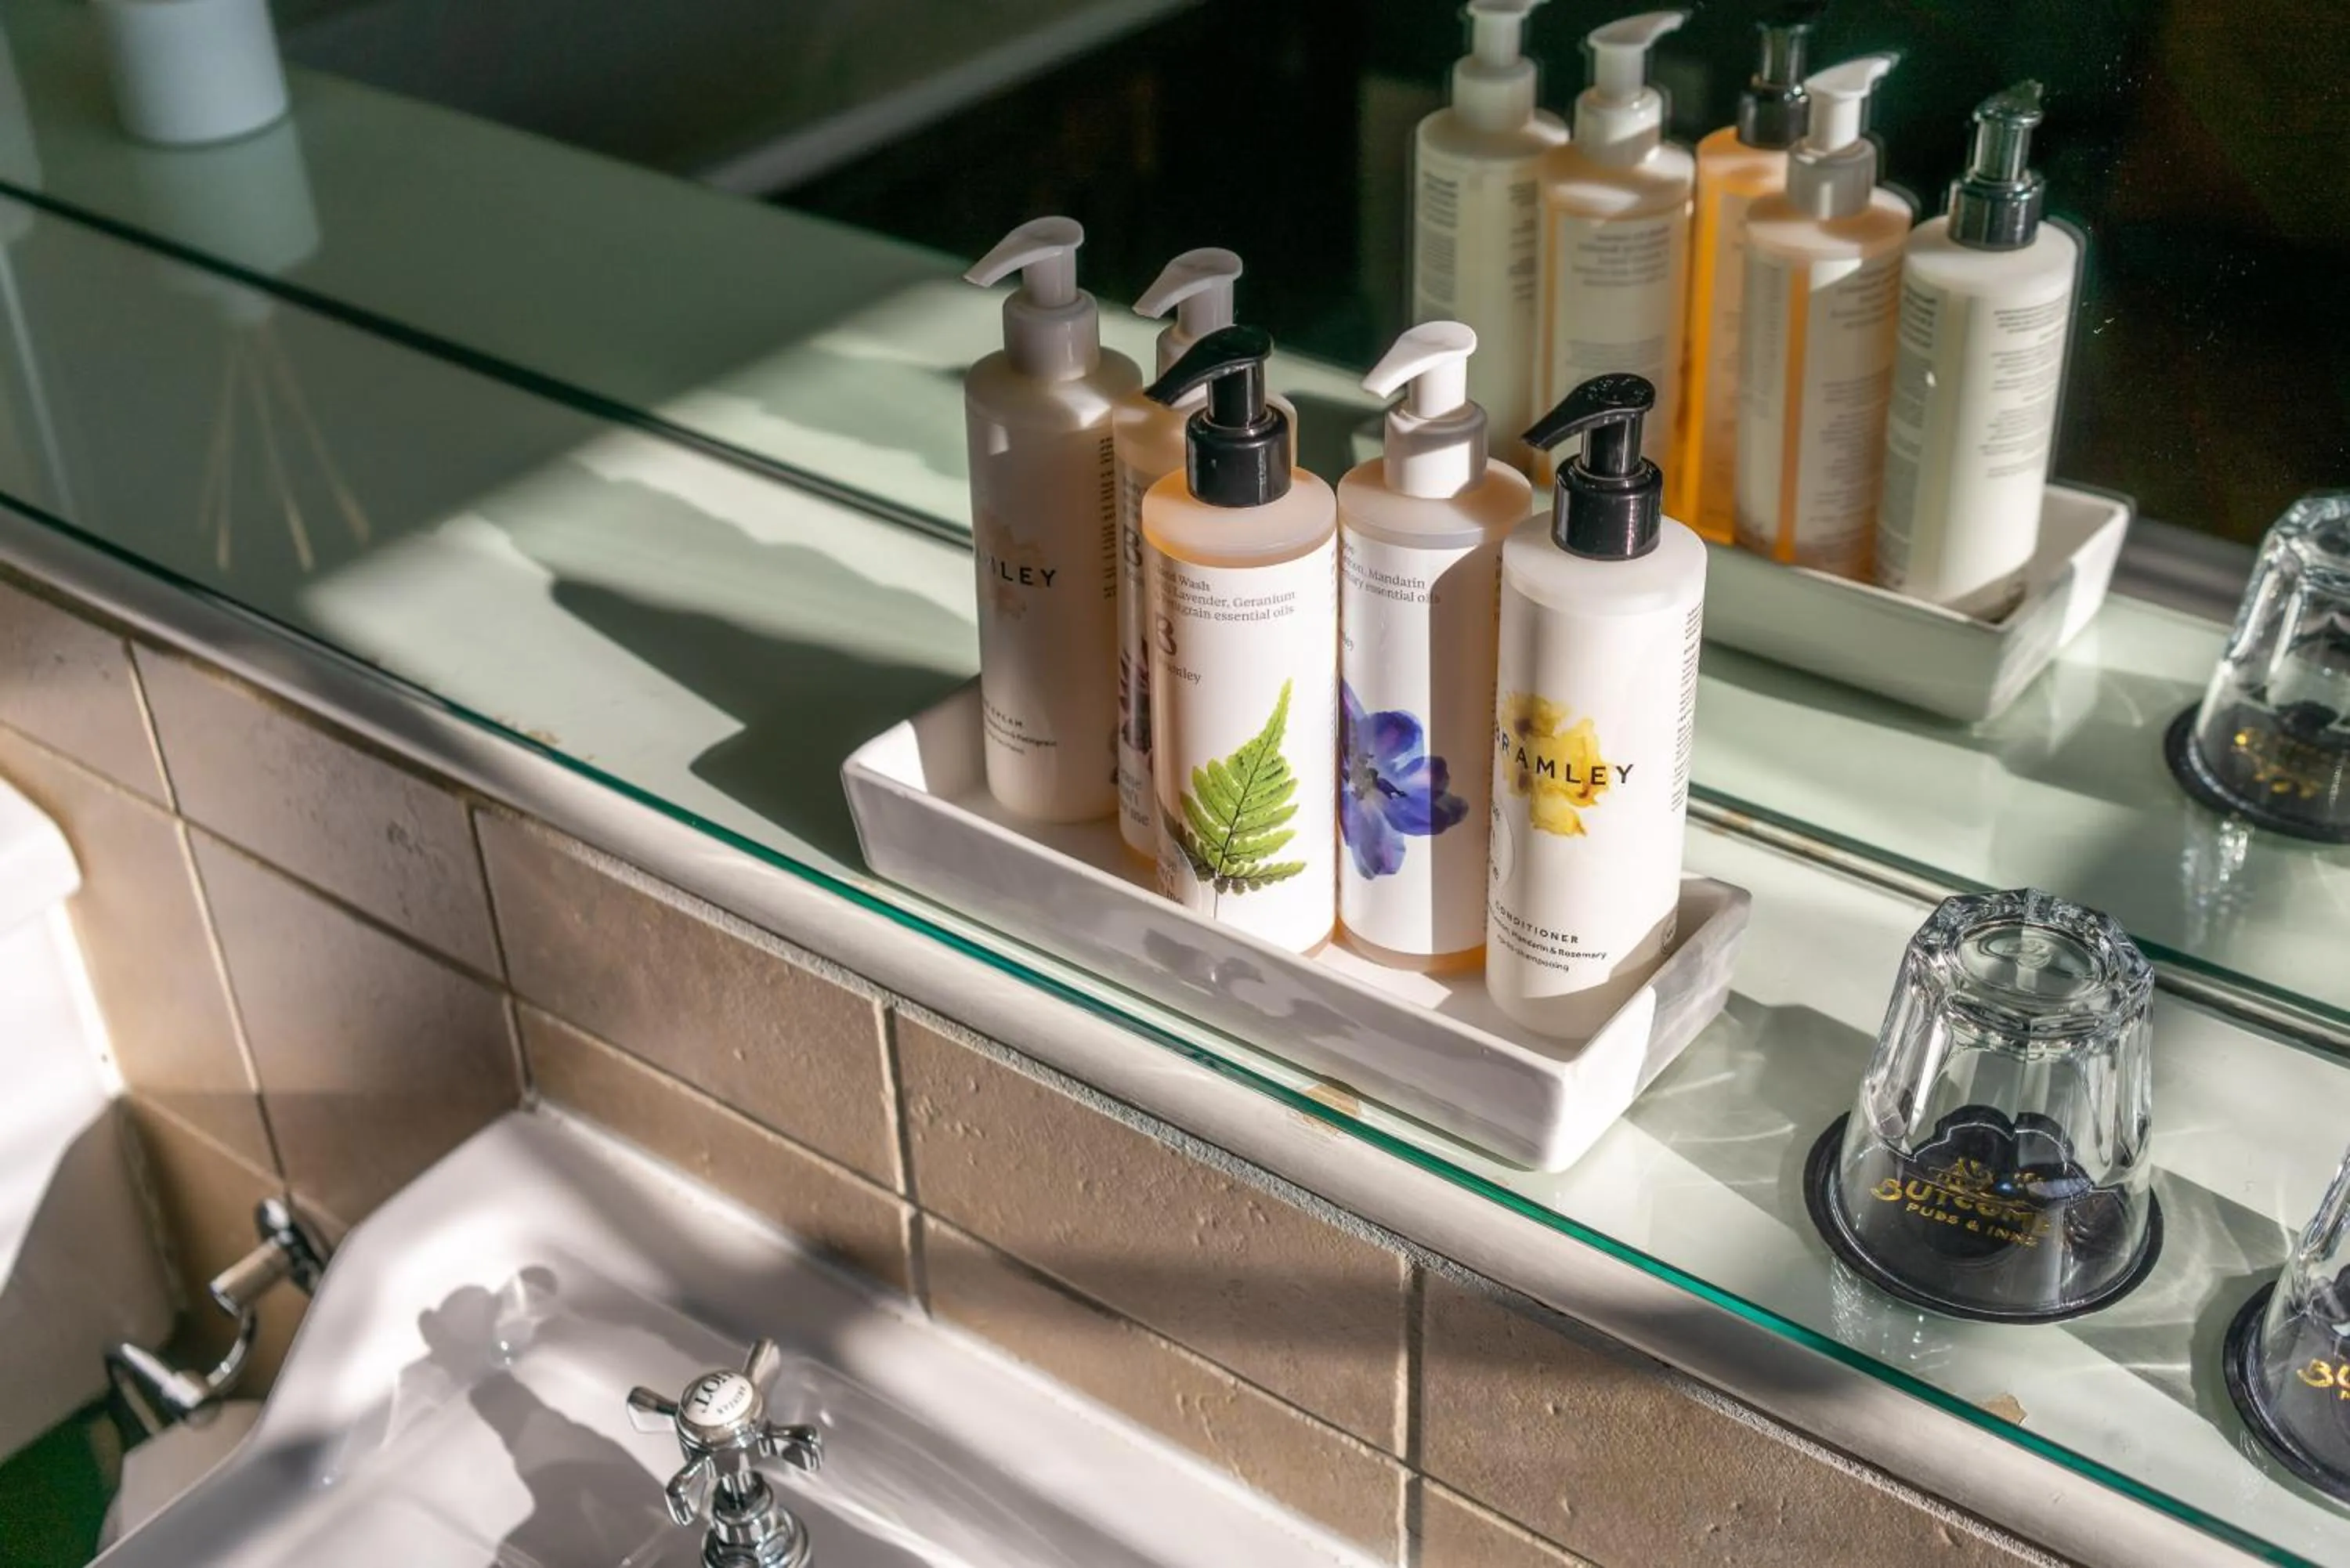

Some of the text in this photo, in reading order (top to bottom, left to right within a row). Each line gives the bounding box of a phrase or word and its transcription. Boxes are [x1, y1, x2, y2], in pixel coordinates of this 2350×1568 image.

[1179, 573, 1210, 591] Wash
[1368, 568, 1425, 589] Mandarin
[1233, 592, 1295, 608] Geranium
[1215, 609, 1271, 621] essential
[1273, 605, 1295, 617] oils
[1495, 901, 1579, 945] CONDITIONER
[1558, 948, 1607, 960] Rosemary
[1870, 1176, 2051, 1234] BUTCOM
